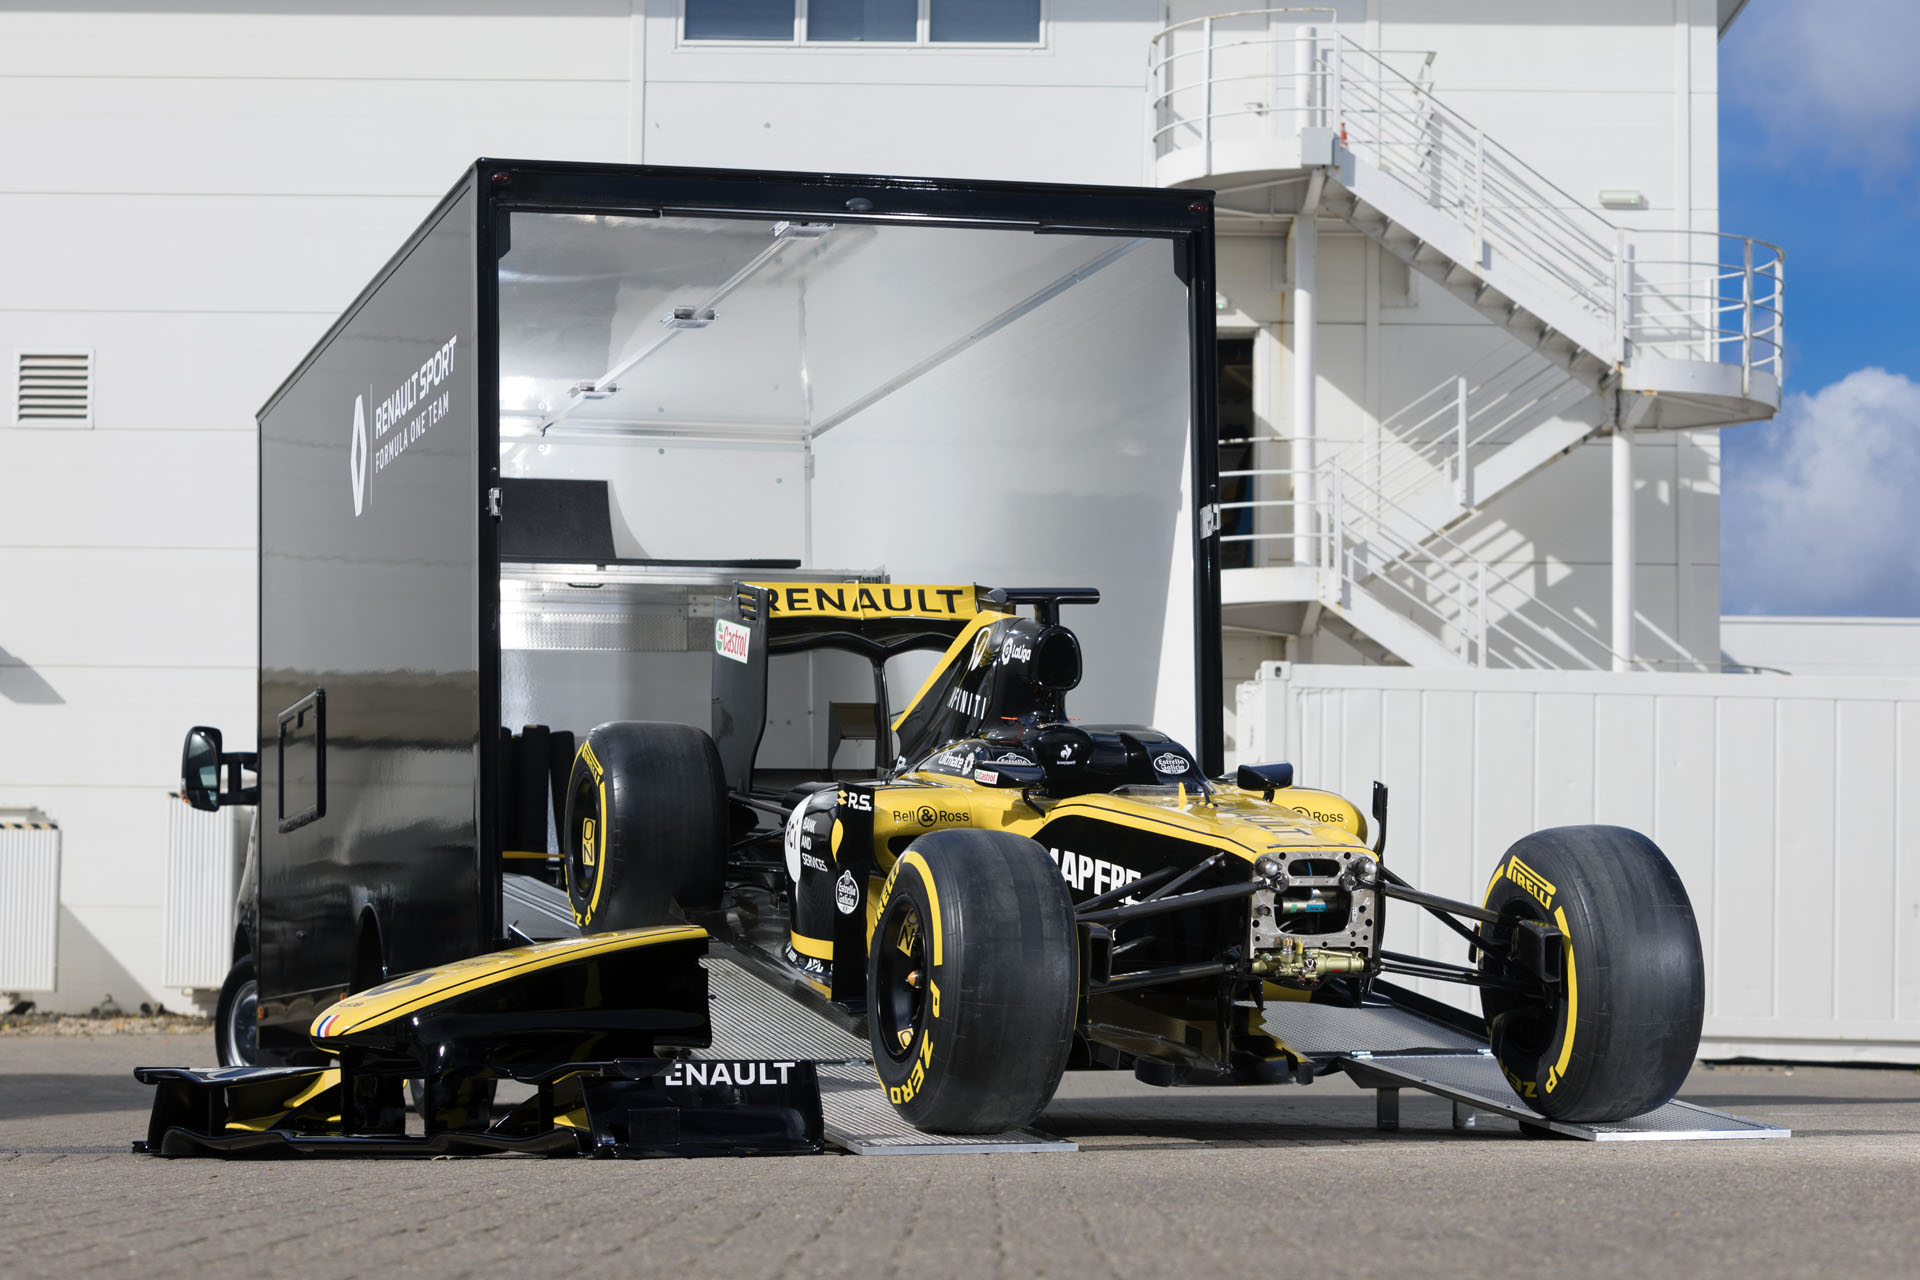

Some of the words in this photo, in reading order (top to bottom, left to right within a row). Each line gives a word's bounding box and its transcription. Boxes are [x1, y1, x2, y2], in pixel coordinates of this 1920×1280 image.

[375, 371, 420, 440] RENAULT
[419, 335, 457, 400] SPORT
[375, 430, 409, 474] FORMULA
[410, 409, 428, 443] ONE
[428, 390, 449, 429] TEAM
[768, 587, 964, 615] RENAULT
[723, 625, 748, 657] Castrol
[978, 771, 996, 783] Castrol
[802, 816, 817, 833] BANK
[893, 810, 915, 823] Bell
[939, 811, 970, 822] Ross
[1312, 811, 1344, 823] Ross
[801, 835, 812, 850] AND
[801, 852, 828, 872] SERVICES
[1506, 855, 1557, 911] PIRELLI
[665, 1062, 796, 1086] ENAULT
[890, 1028, 934, 1105] ZERO
